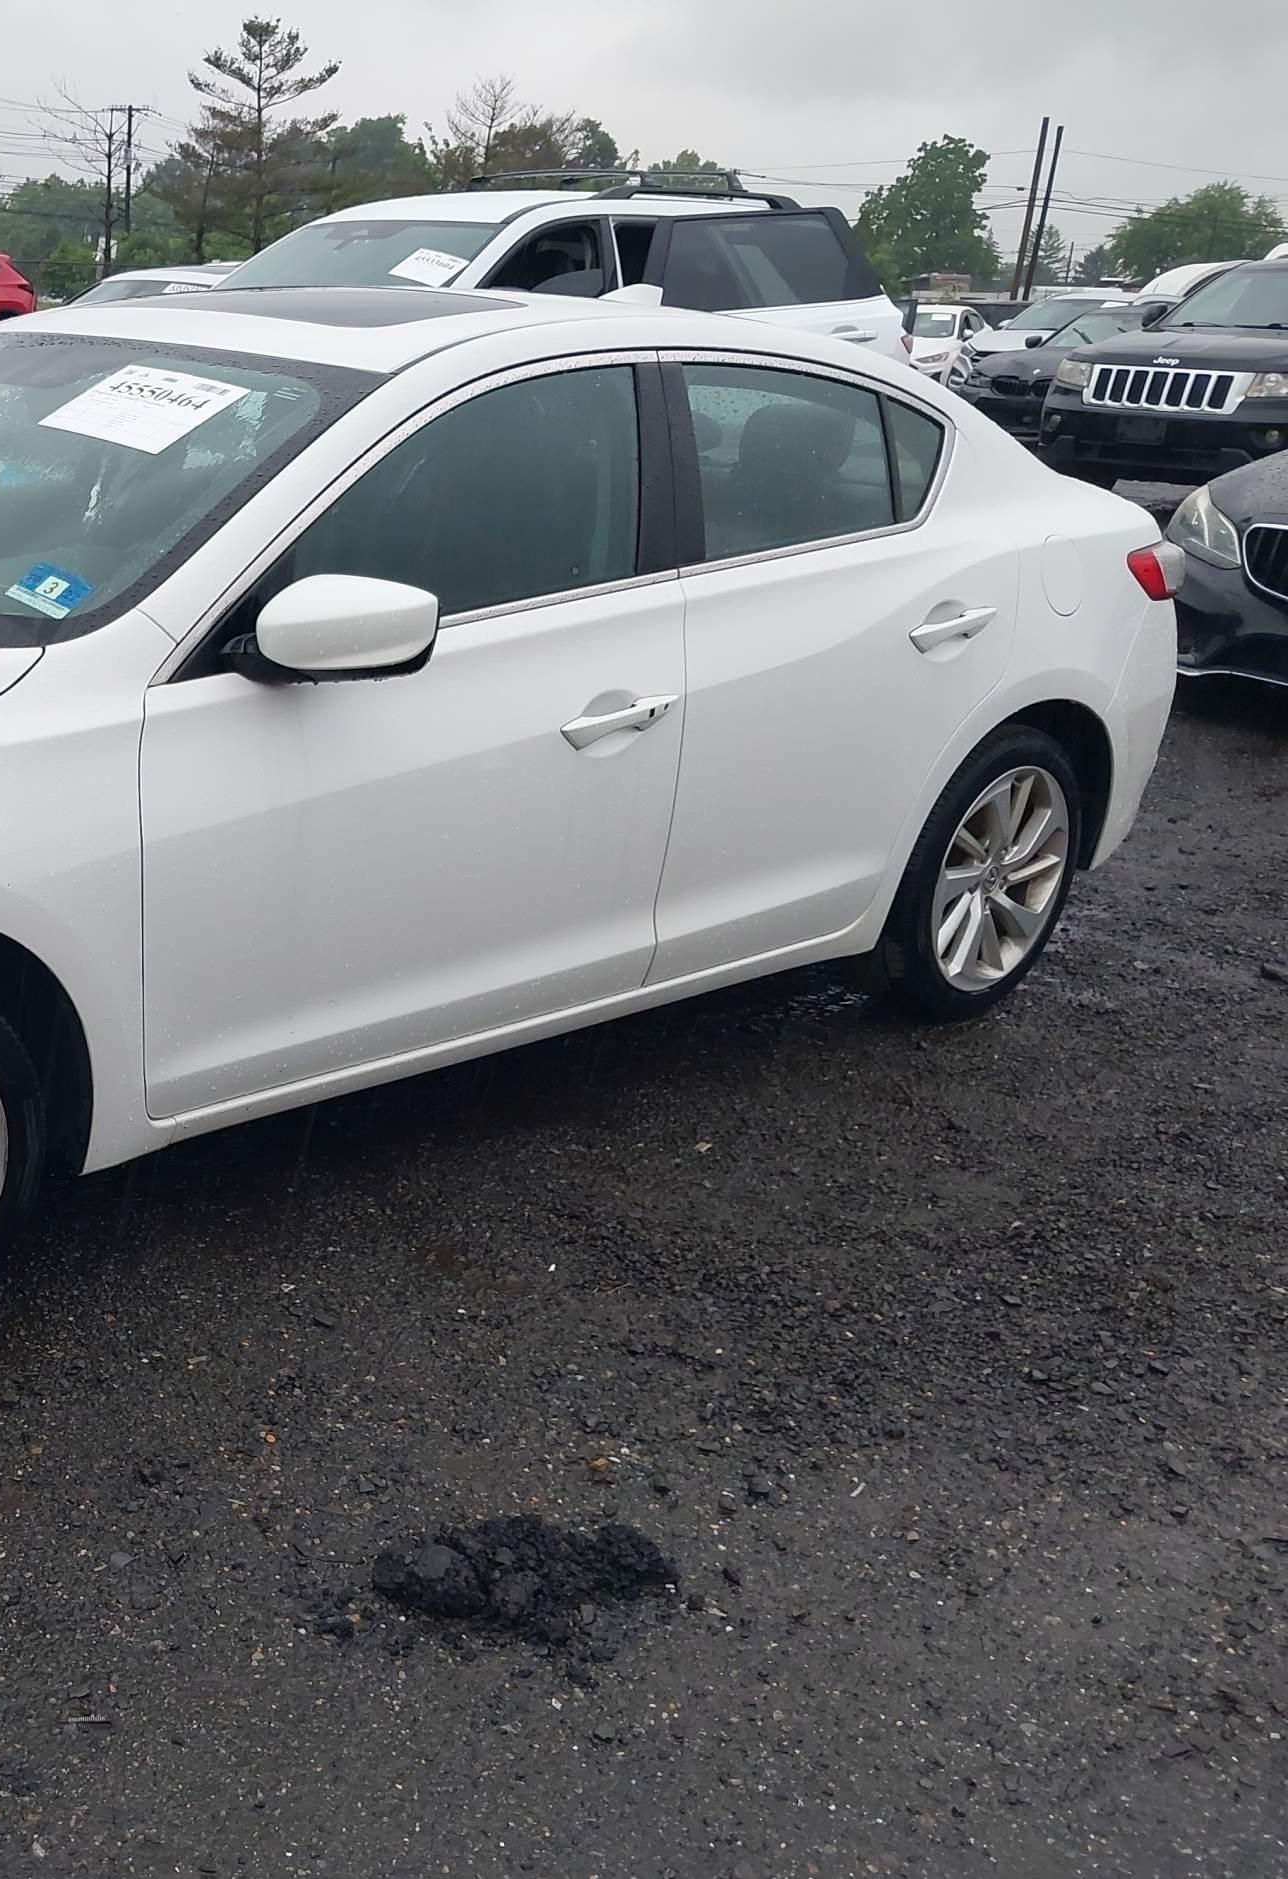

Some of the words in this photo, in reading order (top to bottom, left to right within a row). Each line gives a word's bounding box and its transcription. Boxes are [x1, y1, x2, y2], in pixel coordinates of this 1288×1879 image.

[1152, 356, 1181, 367] Jeep
[109, 380, 212, 411] 45550464
[42, 581, 60, 595] 3
